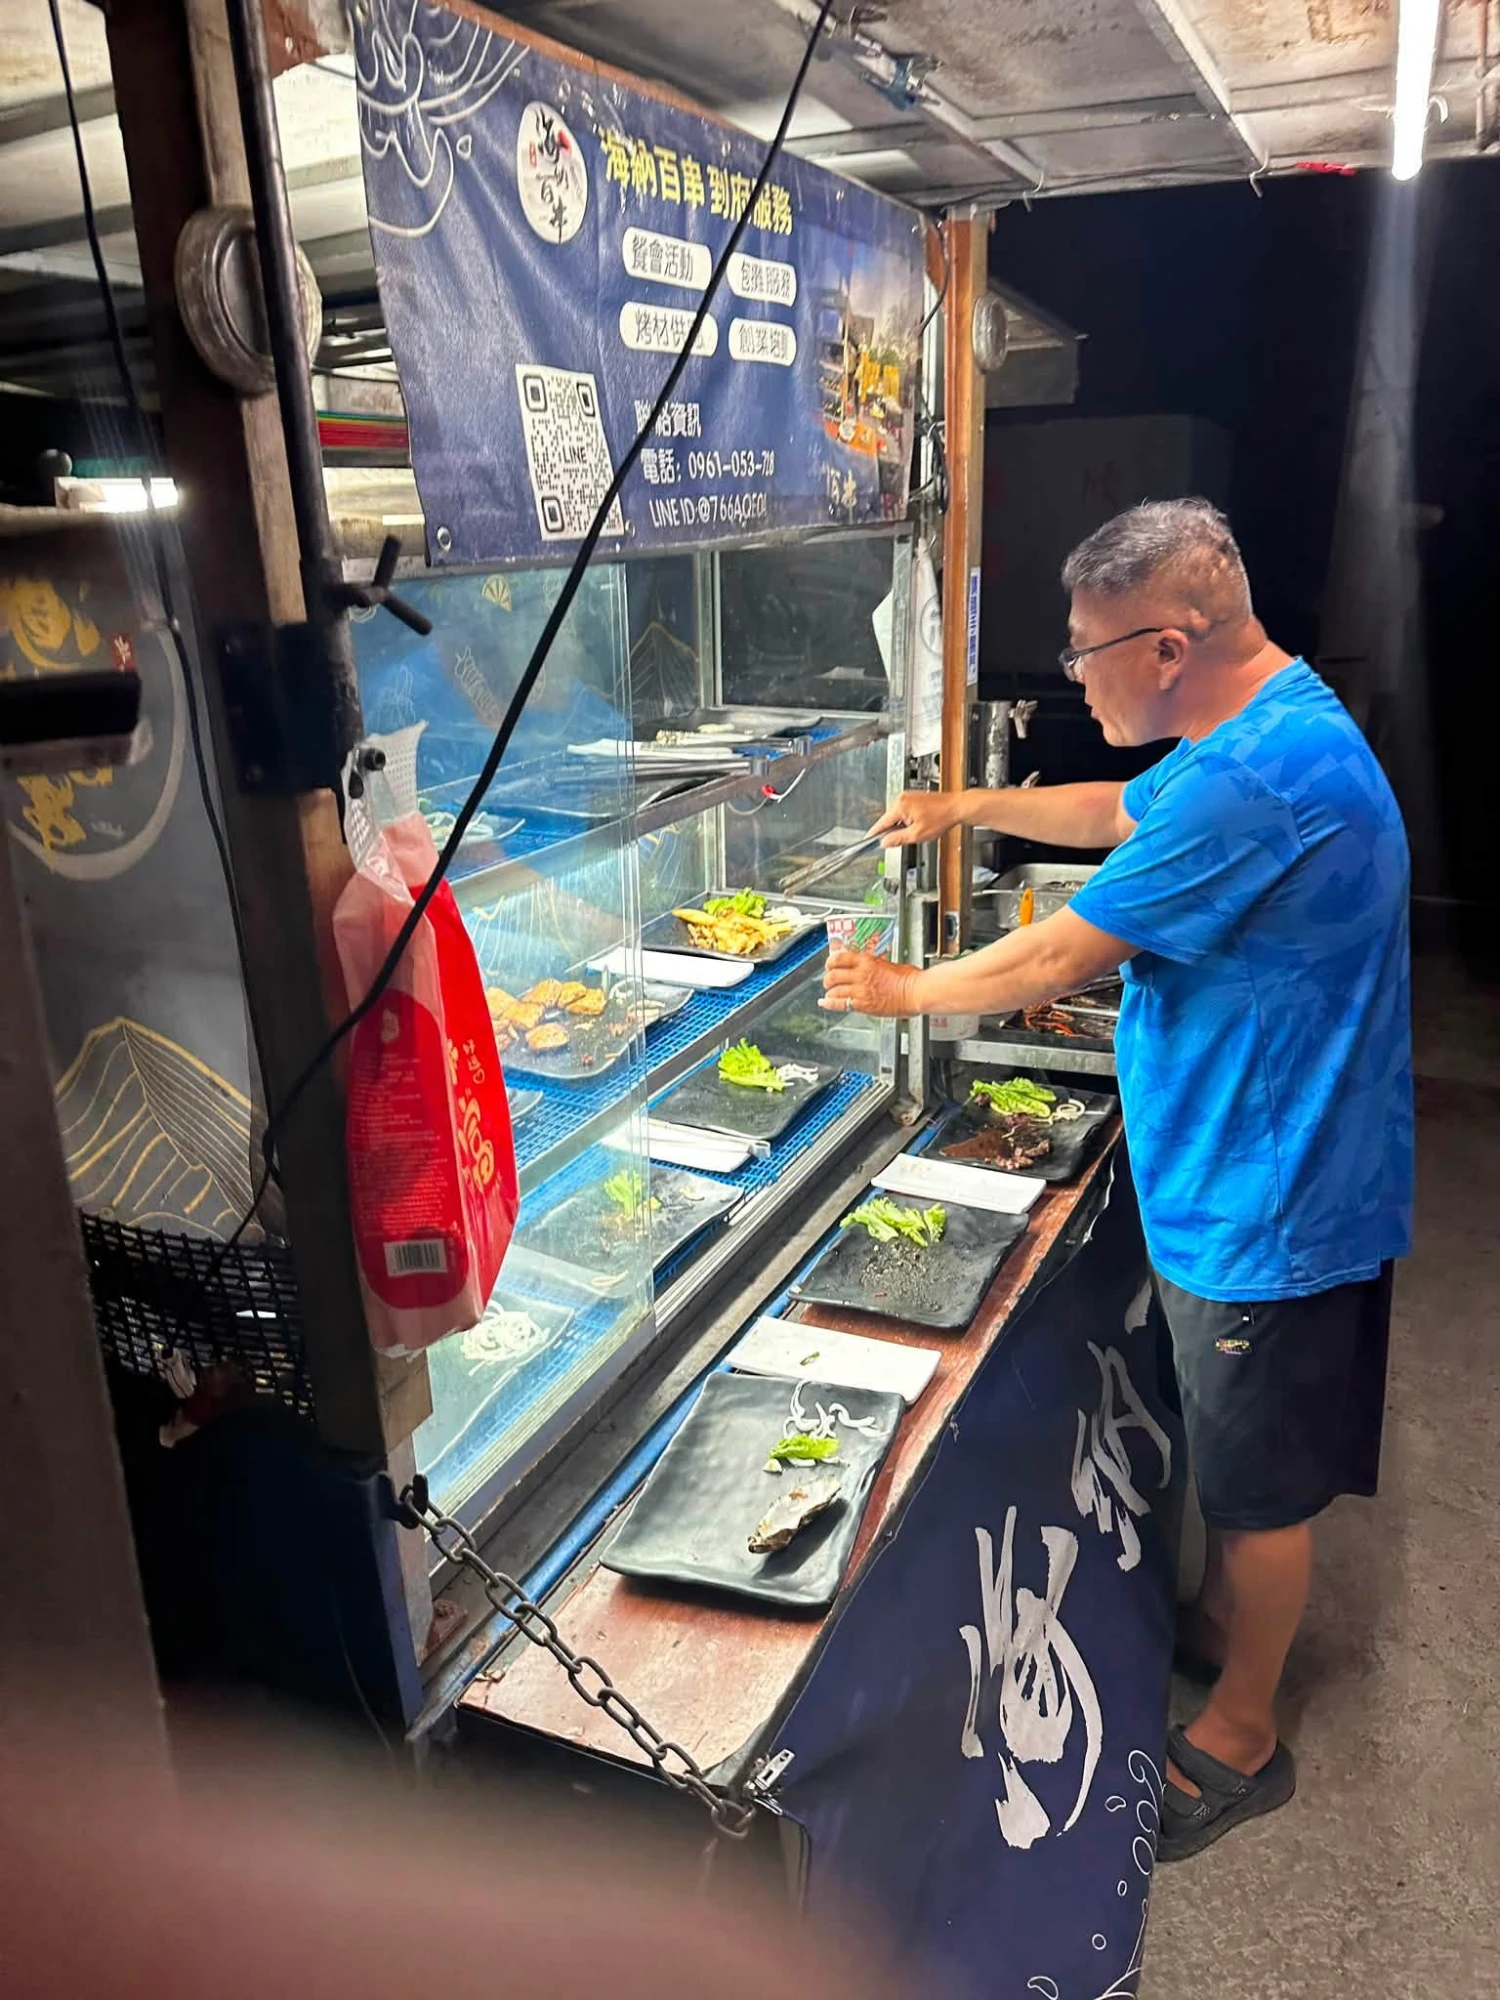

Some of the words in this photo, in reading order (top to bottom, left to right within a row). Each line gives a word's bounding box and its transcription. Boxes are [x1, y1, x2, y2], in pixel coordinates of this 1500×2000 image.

[599, 125, 705, 210] 海納百串
[632, 234, 694, 282] 餐會活動
[562, 445, 588, 463] LINE
[648, 498, 681, 528] LINE
